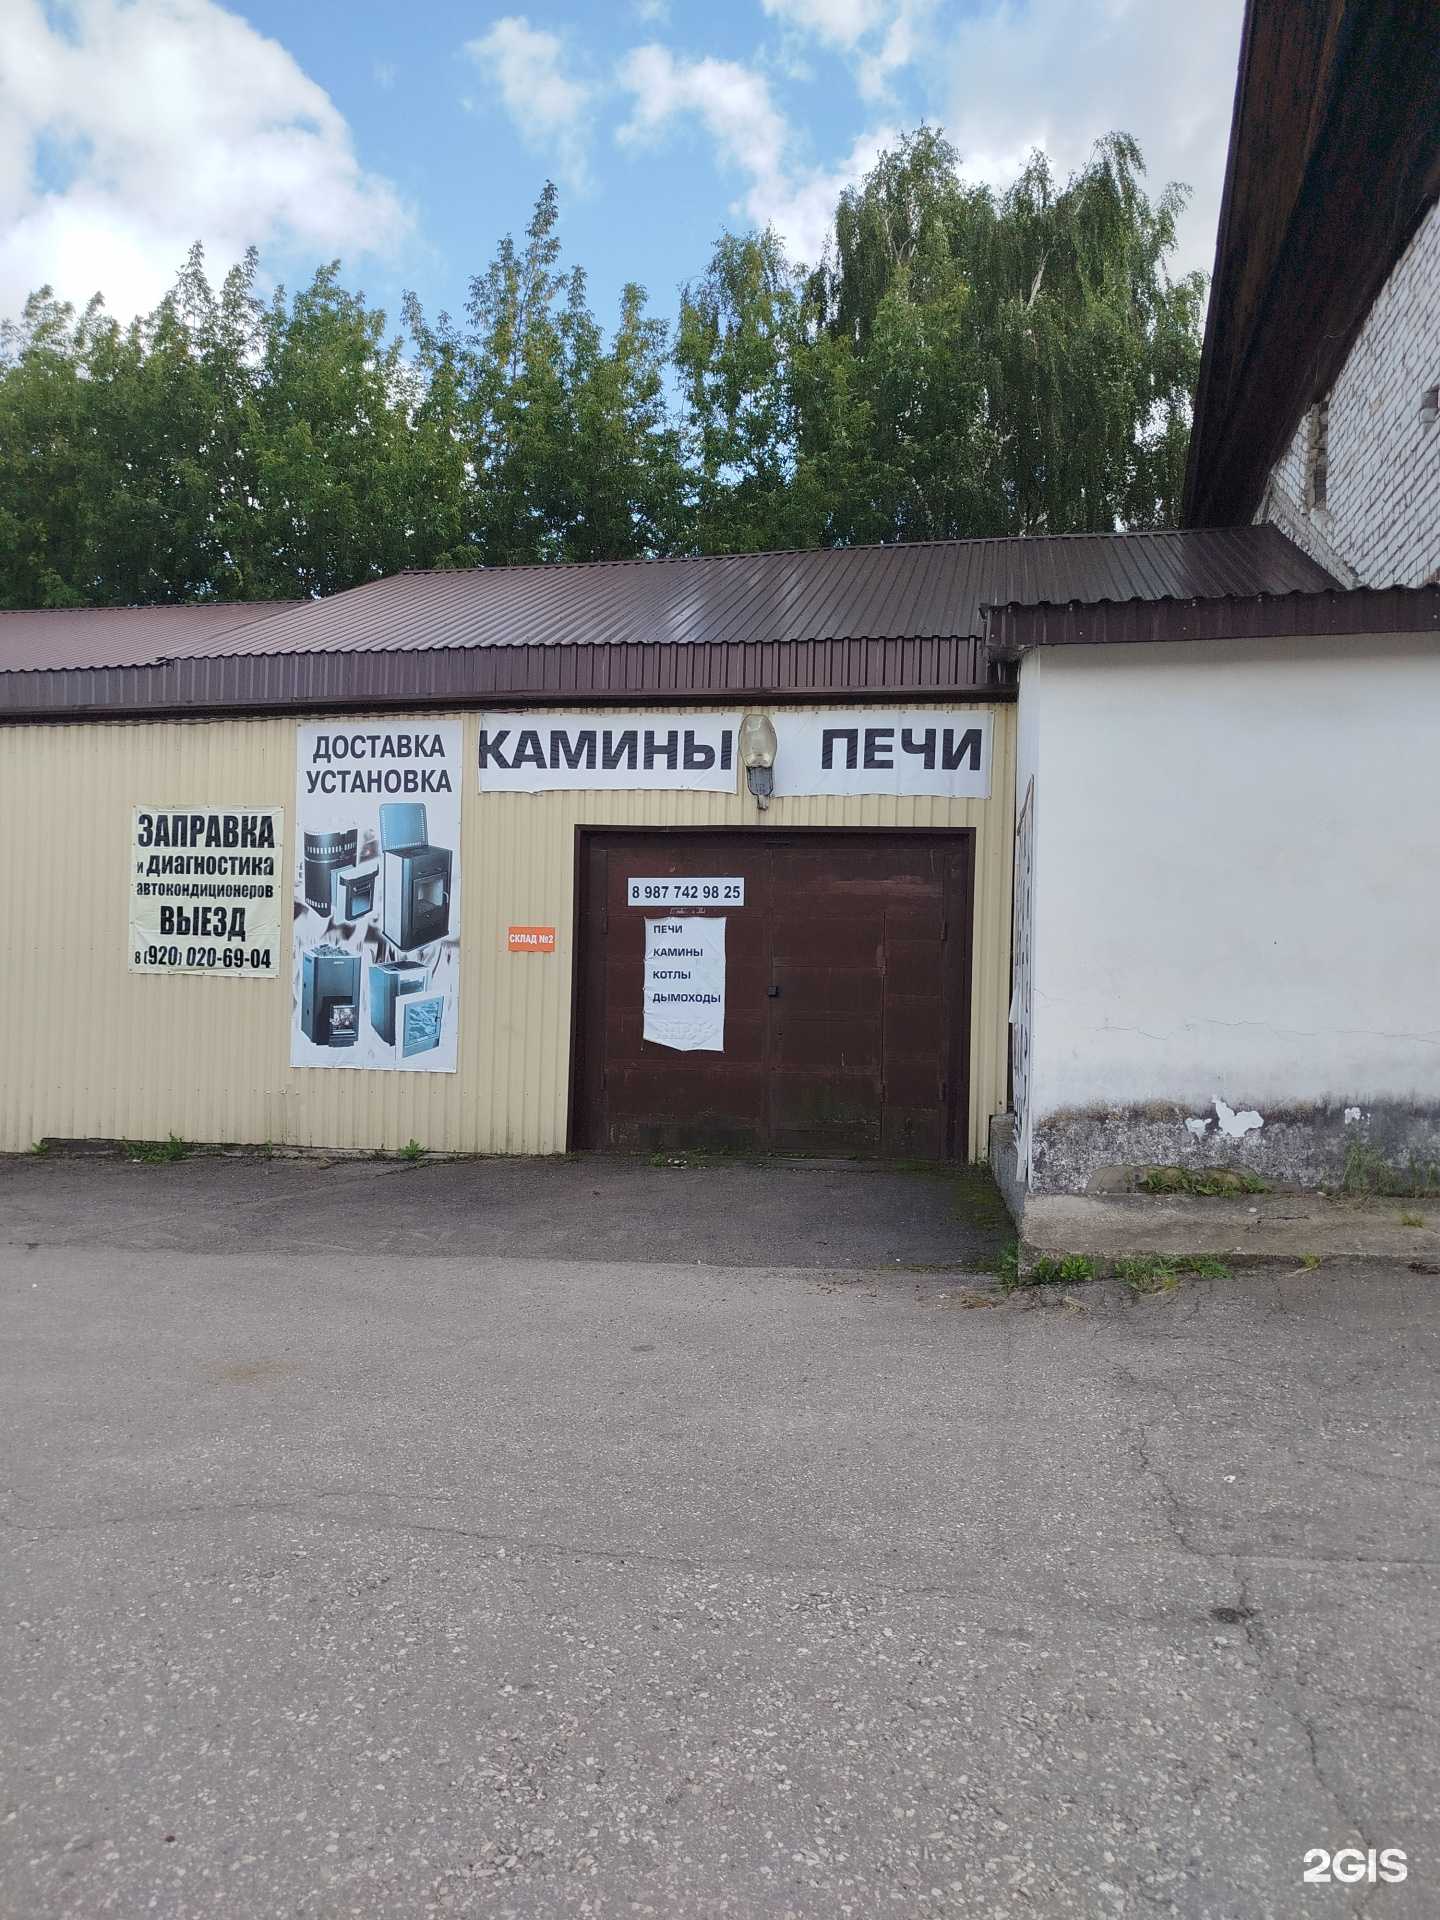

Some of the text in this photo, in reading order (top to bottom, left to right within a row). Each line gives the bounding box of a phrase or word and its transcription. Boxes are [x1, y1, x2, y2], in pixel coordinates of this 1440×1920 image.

[313, 734, 446, 764] ДОСТАВКА
[478, 729, 733, 770] КАМИНЫ
[821, 728, 983, 770] ПЕЧИ
[306, 769, 453, 794] УСТАНОВКА
[137, 814, 275, 849] ЗАПРАВКА
[136, 861, 144, 874] и
[136, 882, 274, 900] автокондиционеров
[631, 885, 741, 899] 8 987 742 98 25
[159, 905, 246, 942] ВЫЕЗД
[653, 925, 683, 934] ПЕЧИ
[510, 934, 554, 945] СКЛАД №2
[134, 945, 272, 969] 8 (920) 020-69-04
[653, 948, 704, 957] КАМИНЫ
[652, 970, 691, 980] КОТЛЫ
[652, 993, 721, 1004] ДЫМОХОДЫ
